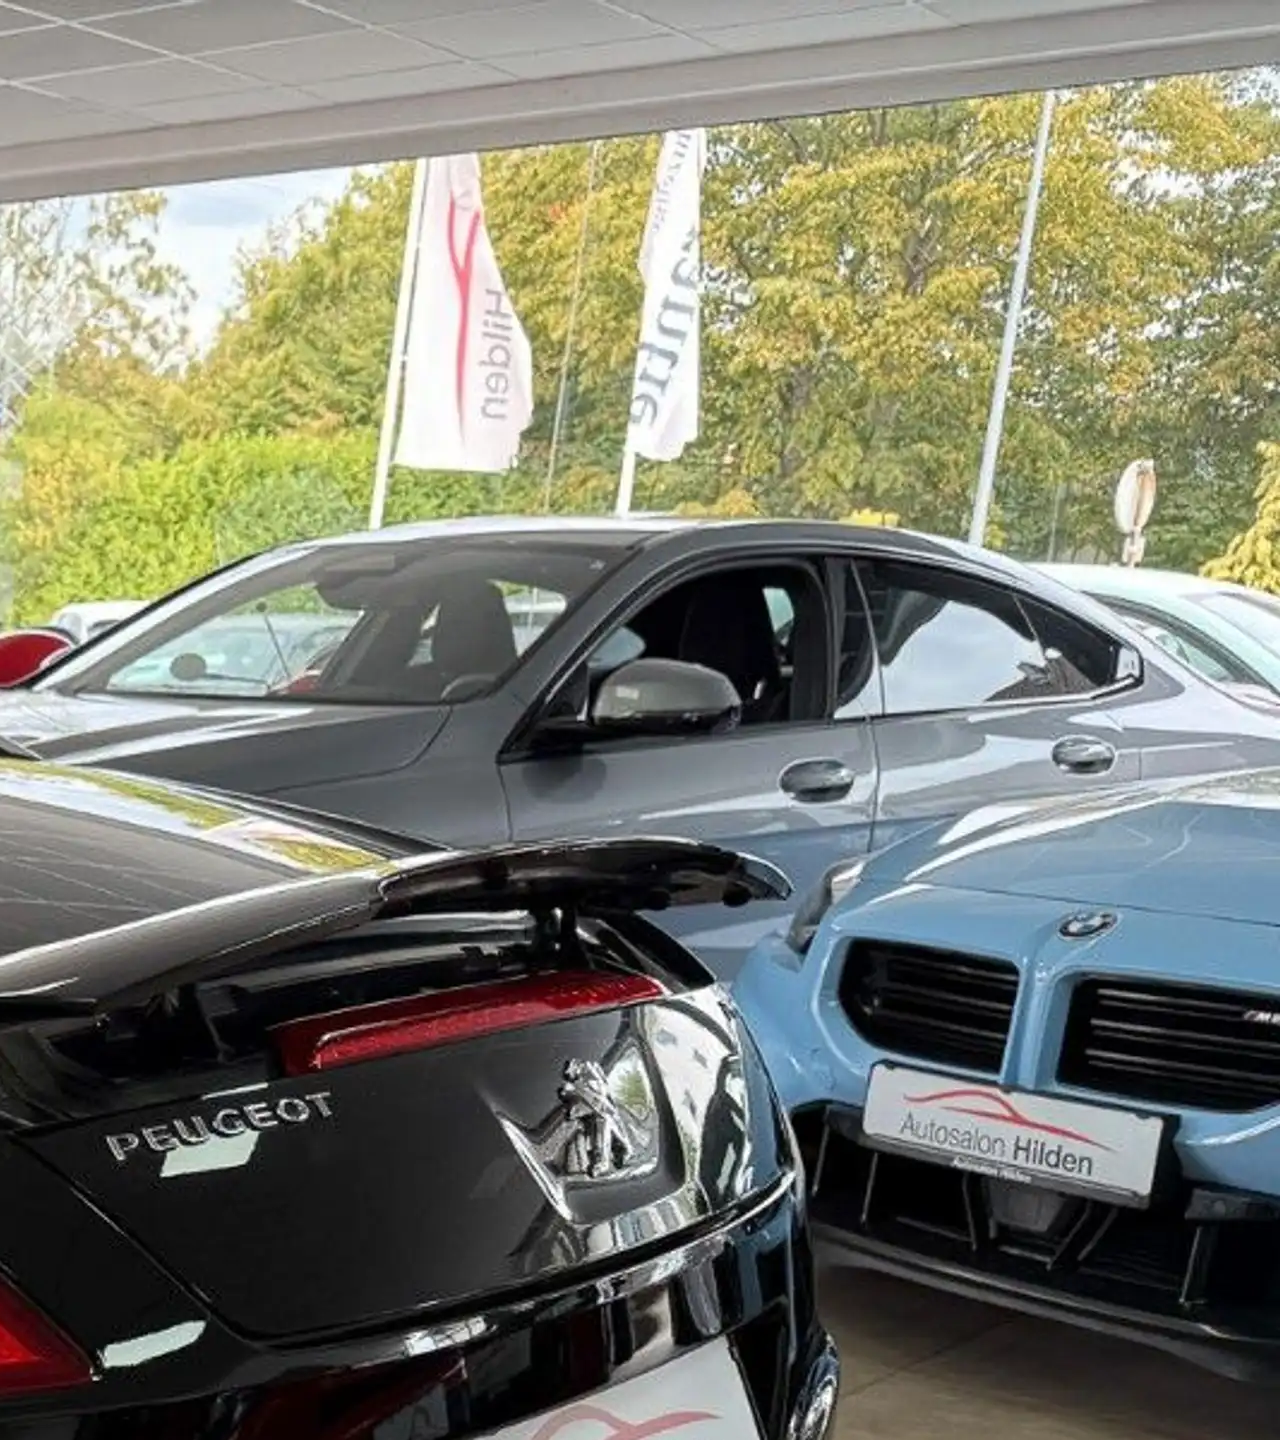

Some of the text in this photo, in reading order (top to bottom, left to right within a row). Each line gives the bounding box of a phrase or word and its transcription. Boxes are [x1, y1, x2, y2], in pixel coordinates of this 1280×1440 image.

[106, 1092, 334, 1161] PEUGEOT
[899, 1110, 1006, 1158] Autosalon
[1012, 1135, 1093, 1176] Hilden
